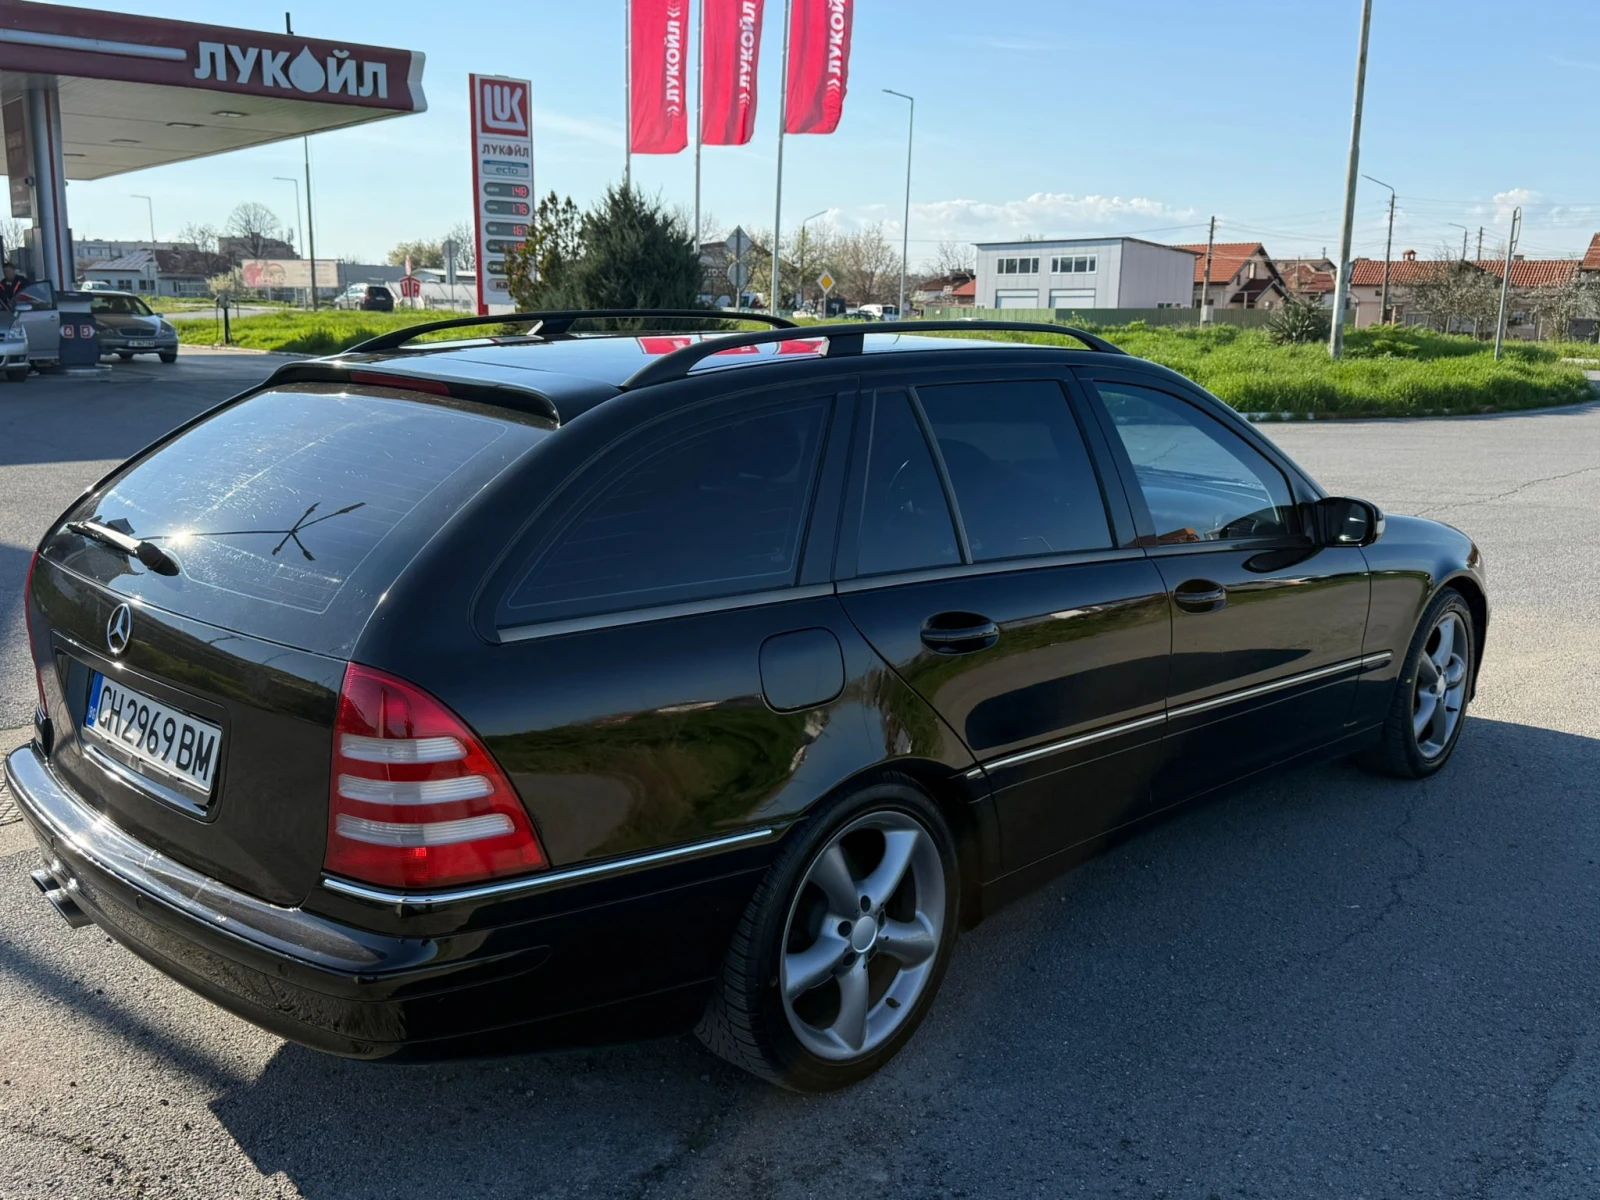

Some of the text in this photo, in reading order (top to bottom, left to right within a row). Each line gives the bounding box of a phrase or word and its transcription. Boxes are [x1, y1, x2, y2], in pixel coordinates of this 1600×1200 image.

[194, 41, 388, 99] ЛУКОЙЛ
[664, 22, 681, 103] ЛУКОЙЛ
[739, 1, 756, 90] ЛУКОЙЛ
[482, 143, 529, 158] ЛУКОЙЛ
[495, 165, 519, 175] ecto
